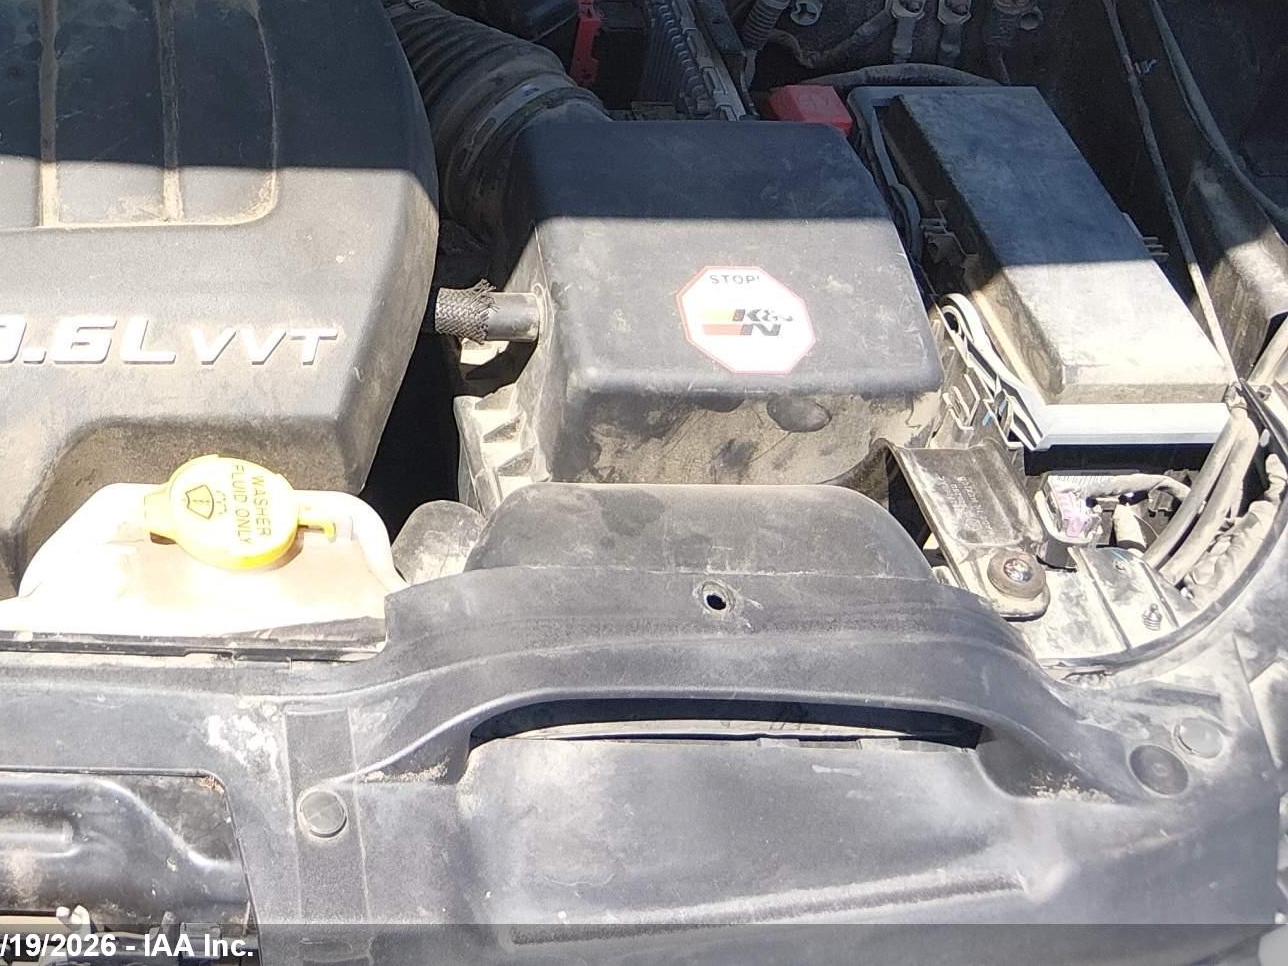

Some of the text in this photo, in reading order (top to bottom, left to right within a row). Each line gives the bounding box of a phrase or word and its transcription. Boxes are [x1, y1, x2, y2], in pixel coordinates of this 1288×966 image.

[191, 326, 340, 366] VVT
[231, 464, 255, 545] FLUID ONLY
[251, 475, 272, 537] WASHER
